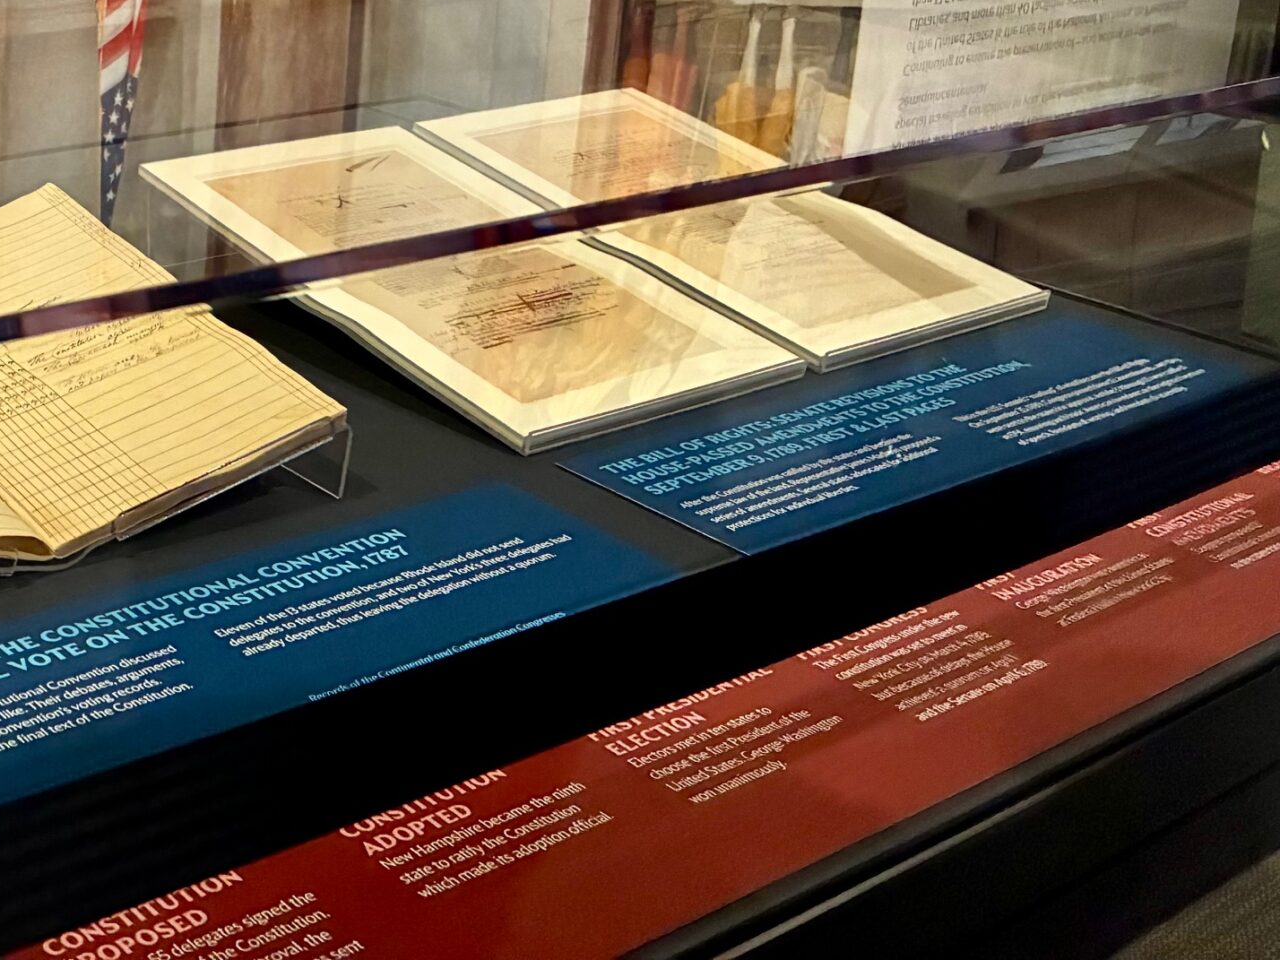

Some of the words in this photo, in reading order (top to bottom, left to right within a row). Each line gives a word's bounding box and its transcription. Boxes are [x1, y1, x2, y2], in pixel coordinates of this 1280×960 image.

[598, 456, 645, 474] THE
[637, 446, 685, 463] BILL
[678, 437, 706, 451] OF
[703, 420, 777, 444] RIGHTS:
[769, 401, 837, 425] SENATE
[828, 378, 914, 407] REVISIONS
[904, 372, 936, 384] TO
[928, 363, 967, 377] THE
[621, 440, 755, 484] HOUSE-PASSED
[754, 407, 867, 446] AMENDMENTS
[858, 400, 890, 413] TO
[882, 390, 923, 406] THE
[643, 457, 754, 495] SEPTEMBER
[745, 453, 774, 464] 9,
[762, 441, 812, 458] 1789,
[801, 426, 854, 447] FIRST
[848, 422, 871, 433] &
[861, 410, 908, 428] LAST
[900, 396, 956, 416] PAGES
[6, 641, 86, 671] VOTE
[85, 628, 130, 649] ON
[125, 612, 185, 635] THE
[183, 560, 367, 619] CONSTITUTION,
[361, 544, 408, 565] 1787
[40, 573, 259, 642] CONSTITUTIONAL
[257, 528, 406, 577] CONVENTION
[810, 657, 839, 670] The
[830, 648, 861, 663] First
[853, 633, 901, 655] Congress
[896, 622, 926, 638] under
[920, 616, 944, 628] the
[937, 609, 960, 621] new
[15, 726, 49, 744] final
[46, 718, 76, 734] text
[74, 712, 91, 725] of
[89, 707, 114, 720] the
[111, 682, 193, 712] Constitution.
[604, 710, 705, 756] ELECTION
[626, 745, 678, 768] Electors
[672, 735, 701, 750] met
[692, 730, 712, 742] in
[705, 723, 730, 736] ten
[725, 711, 760, 729] states
[754, 706, 772, 716] to
[363, 803, 471, 855] ADOPTED
[378, 851, 414, 870] New
[409, 823, 484, 857] Hampshire
[477, 803, 533, 829] became
[528, 794, 555, 808] the
[551, 781, 586, 800] ninth
[398, 864, 435, 884] state
[430, 858, 451, 870] to
[447, 844, 485, 864] ratify
[480, 835, 508, 849] the
[502, 804, 581, 839] Constitution
[416, 875, 460, 897] which
[457, 860, 498, 881] made
[491, 853, 515, 866] its
[511, 829, 571, 858] adoption
[42, 870, 241, 955] CONSTITUTION
[71, 909, 207, 960] ROPOSED
[170, 922, 243, 957] delegates
[241, 899, 292, 927] signed
[287, 891, 316, 908] the
